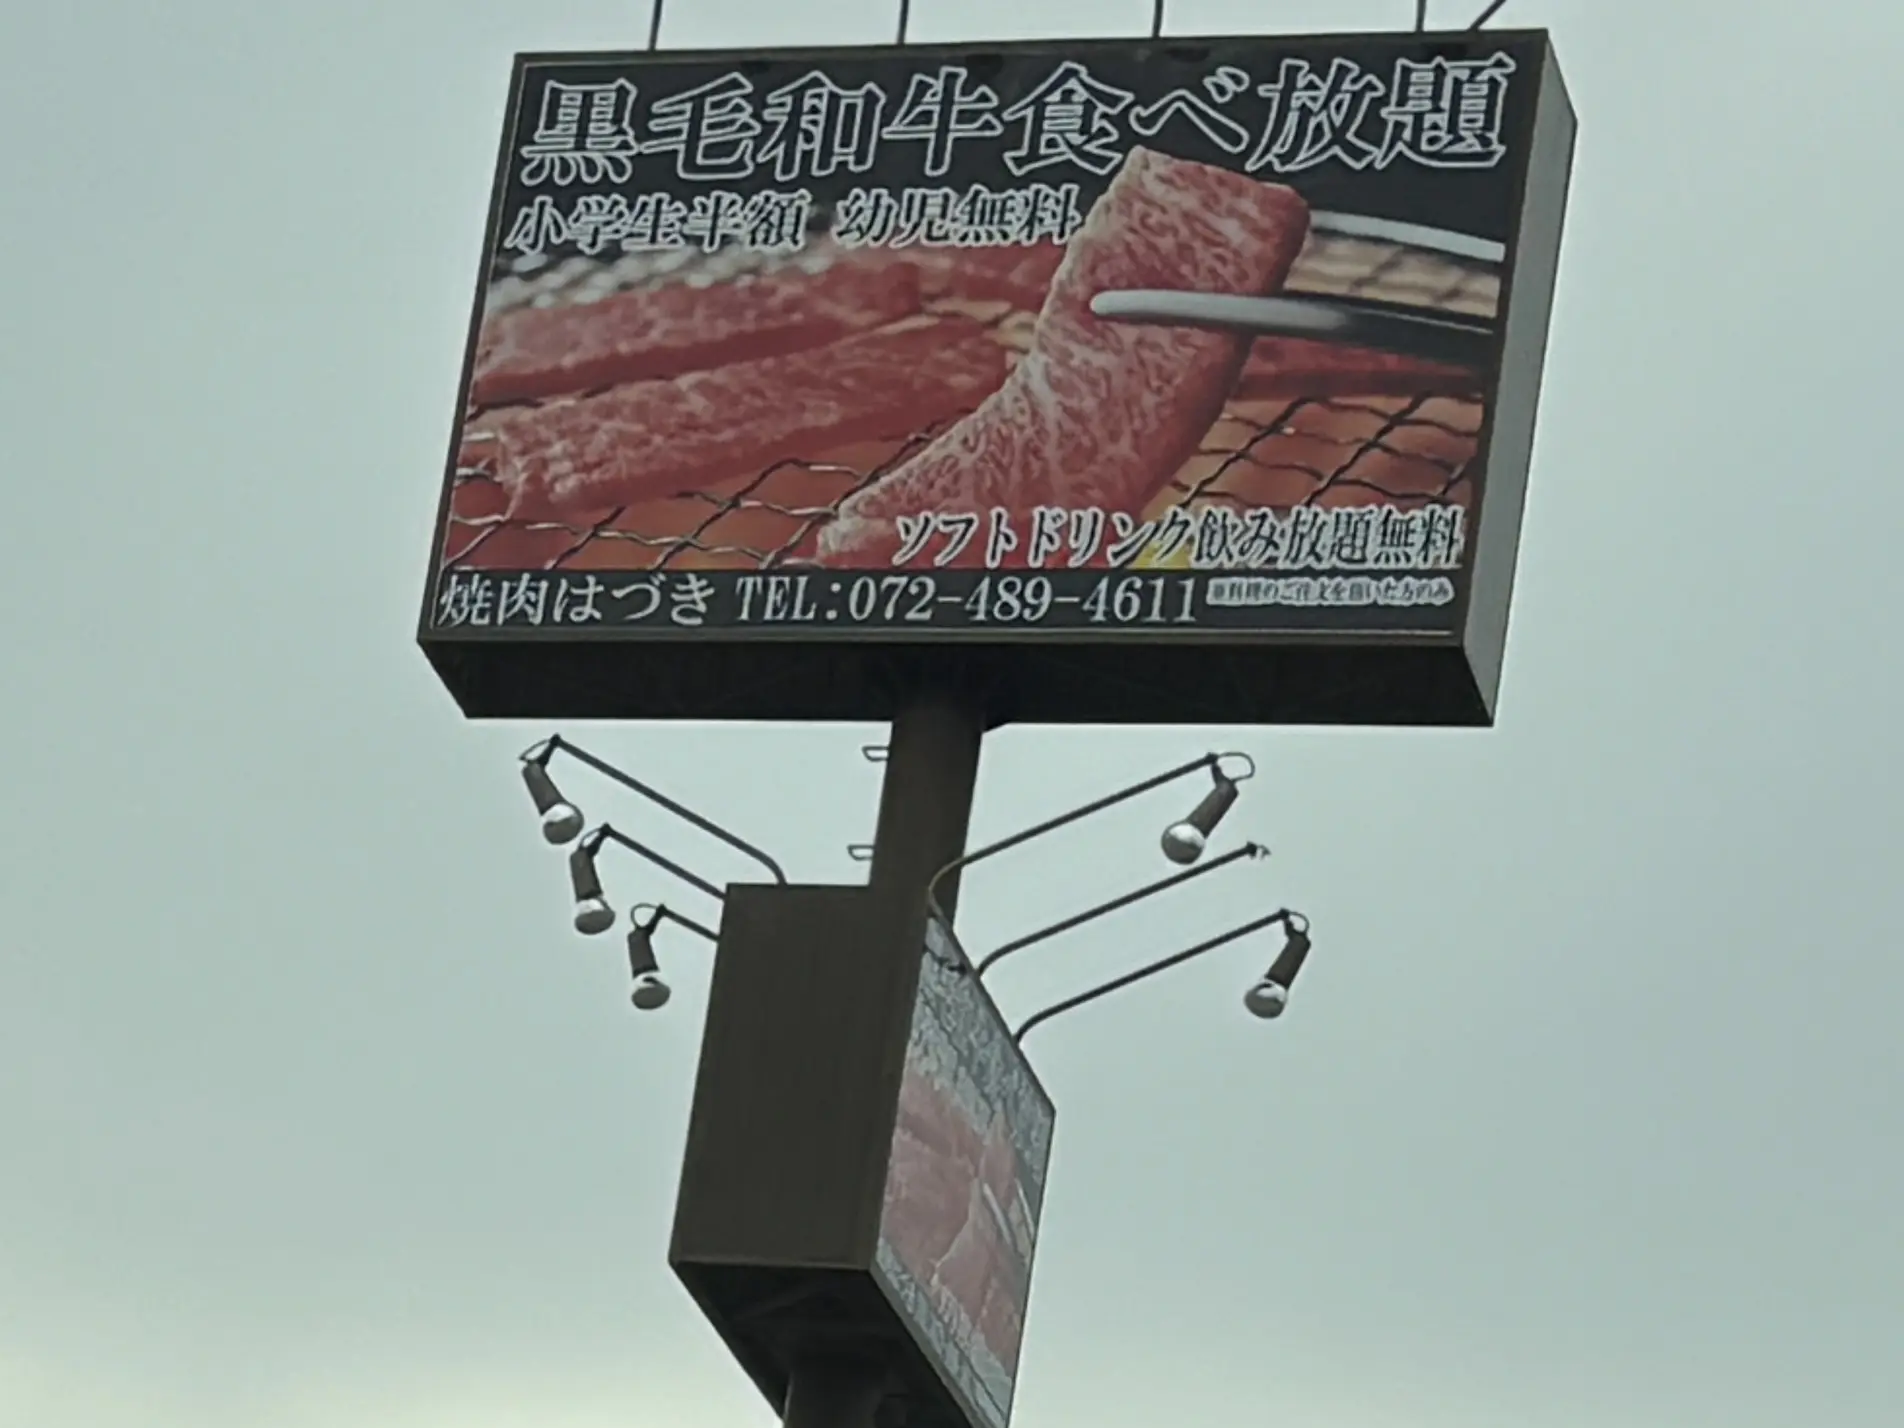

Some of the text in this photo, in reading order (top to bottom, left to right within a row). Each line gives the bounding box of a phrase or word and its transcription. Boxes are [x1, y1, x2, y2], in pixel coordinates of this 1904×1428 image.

[522, 55, 1514, 187] 黒毛和牛食べ放題
[504, 184, 1084, 254] 小学生半額 幼児無料
[894, 505, 1464, 570] ソフトドリンク飲み放題無料
[438, 572, 1197, 628] 焼肉はづき TEL:072-489-4611
